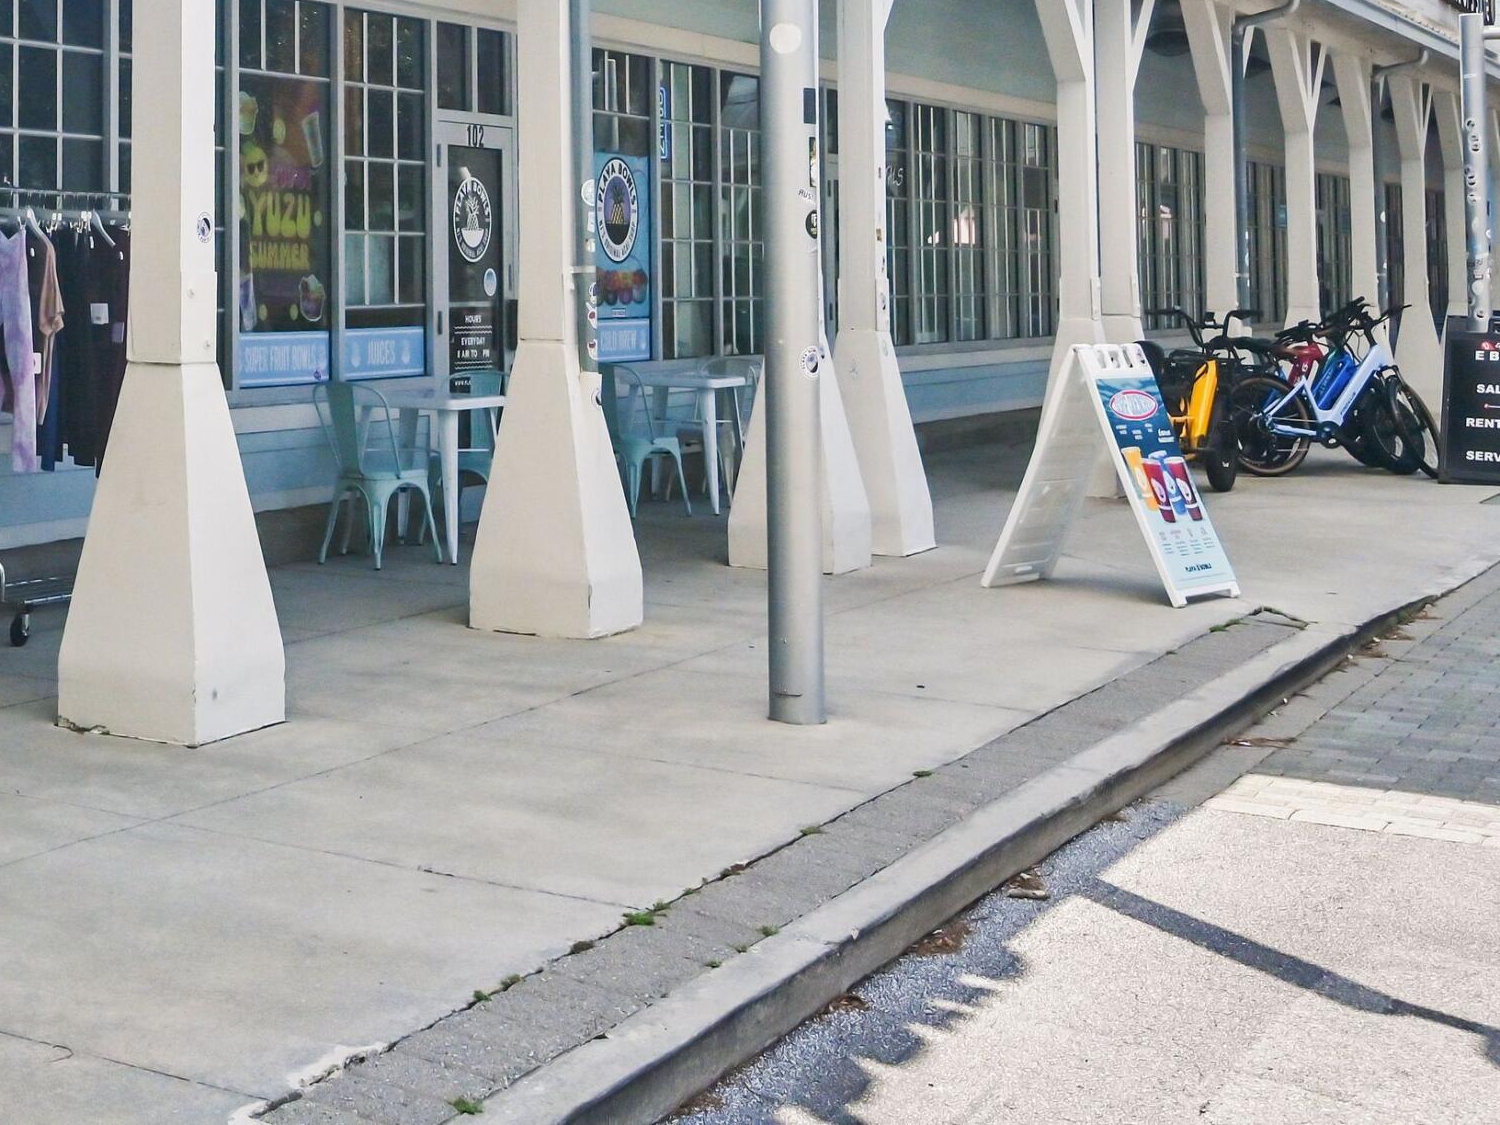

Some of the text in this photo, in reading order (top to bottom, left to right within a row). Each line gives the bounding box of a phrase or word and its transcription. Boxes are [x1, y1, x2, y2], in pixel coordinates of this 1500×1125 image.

[467, 124, 485, 148] 102
[598, 162, 636, 206] PLAYA BOWLS
[248, 191, 312, 239] YUZU
[249, 241, 310, 270] SUMMER
[465, 315, 482, 324] HOURS
[270, 345, 291, 372] FRUIT
[367, 340, 396, 365] JUICES
[1475, 350, 1485, 361] E
